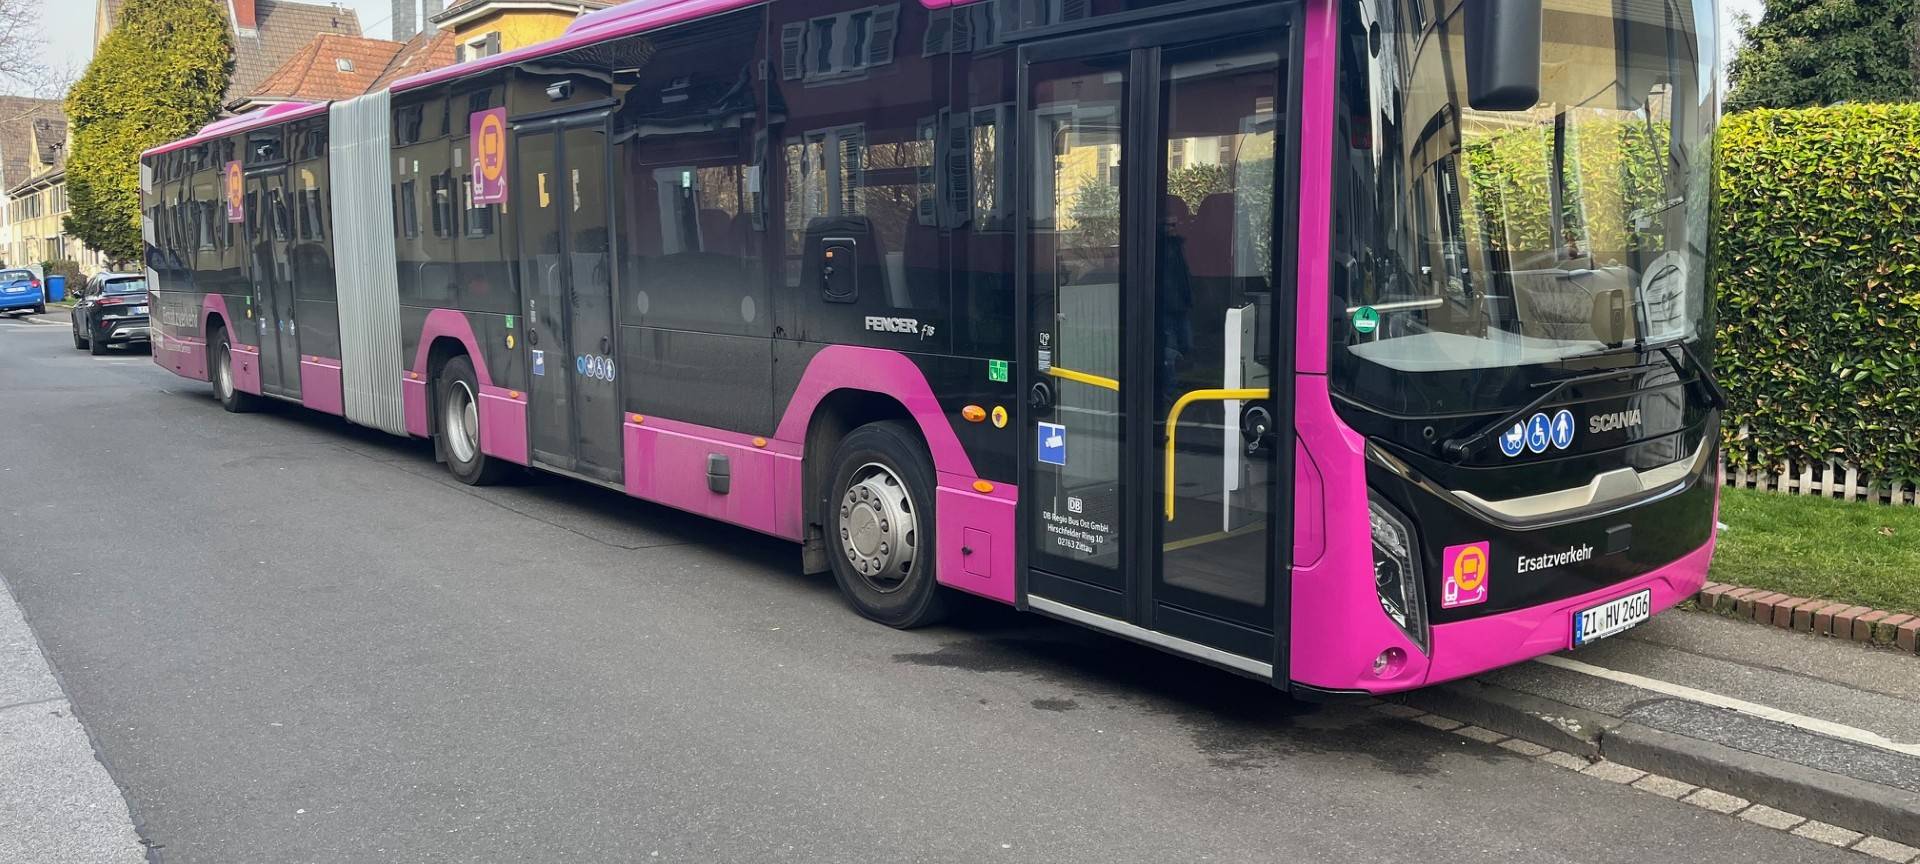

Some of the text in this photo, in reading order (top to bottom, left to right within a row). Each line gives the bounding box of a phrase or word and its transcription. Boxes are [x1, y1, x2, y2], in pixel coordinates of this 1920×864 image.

[865, 316, 918, 333] FENCER
[1362, 308, 1370, 320] 4
[1589, 409, 1642, 434] SCANIA
[1043, 511, 1109, 533] DB Regio Bus Ost GmbH
[1047, 523, 1103, 544] Hirschfelder Ring 10
[1057, 537, 1093, 553] 02763 Zittau
[1517, 542, 1594, 574] Ersatzverkehr
[1583, 611, 1597, 636] ZI
[1606, 602, 1620, 629] HV
[1622, 593, 1648, 622] 2606
